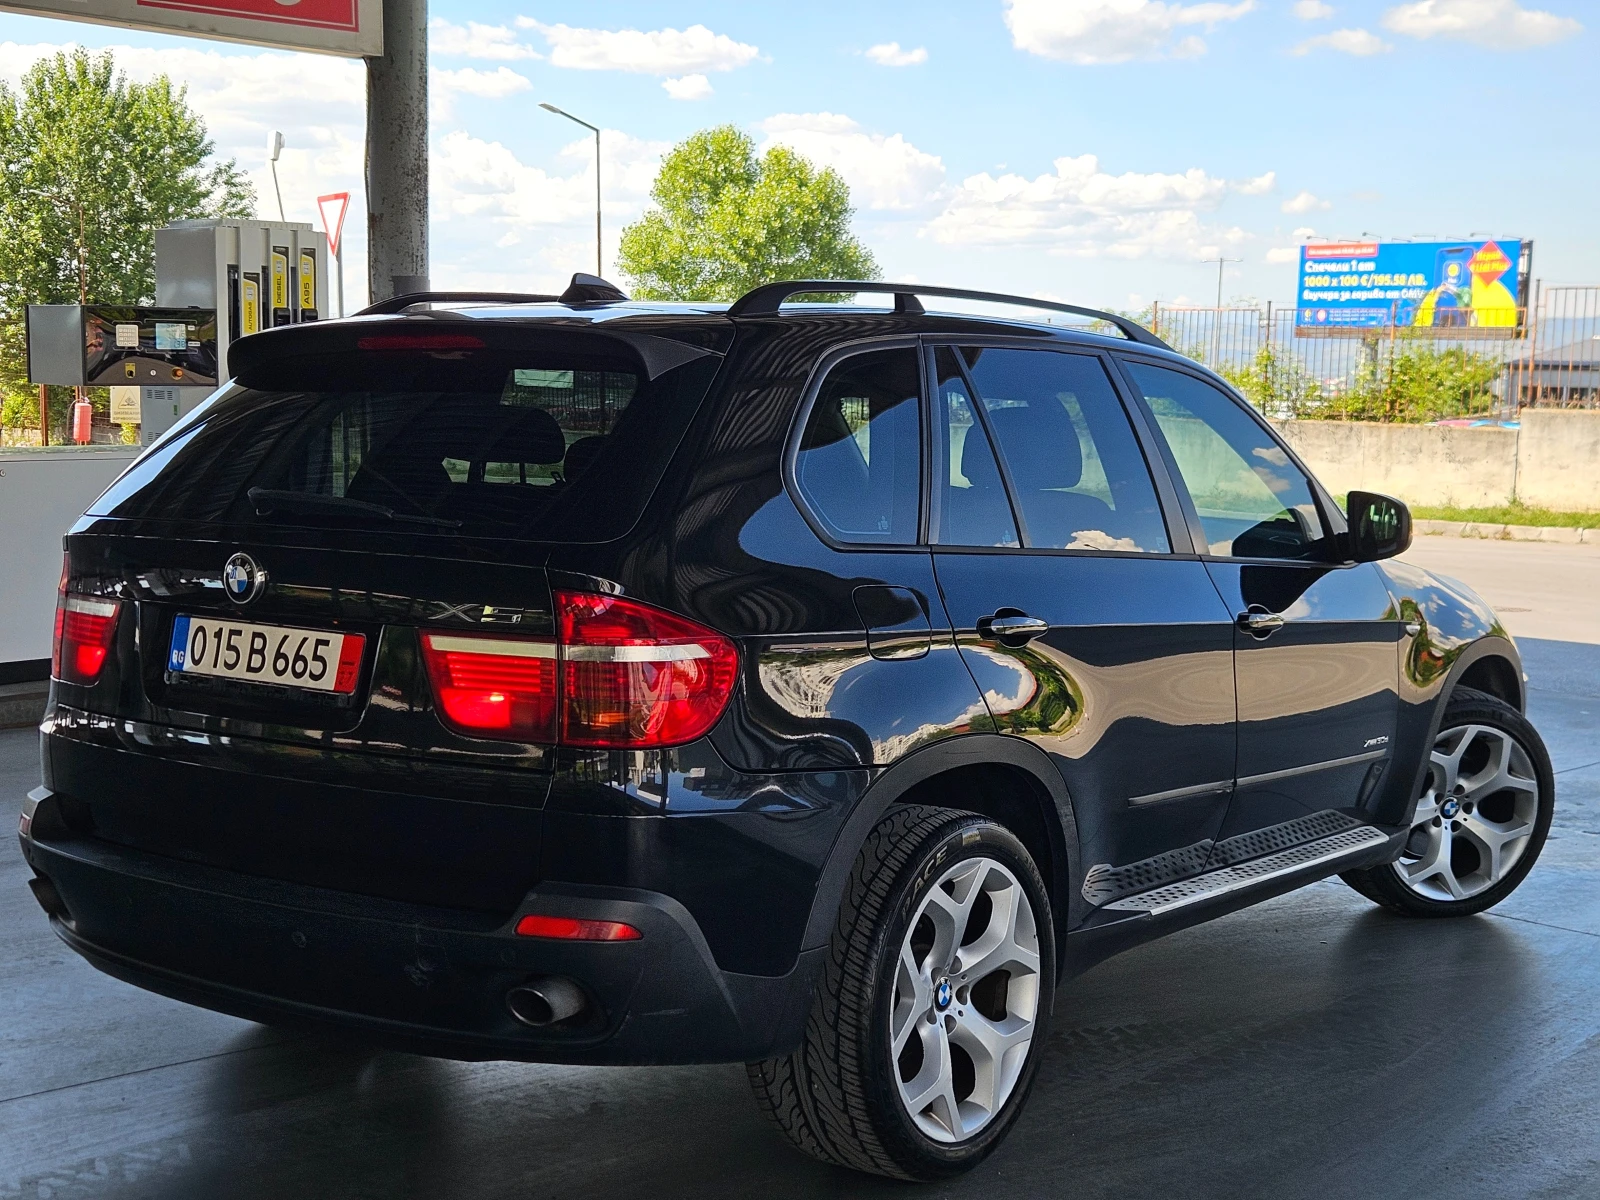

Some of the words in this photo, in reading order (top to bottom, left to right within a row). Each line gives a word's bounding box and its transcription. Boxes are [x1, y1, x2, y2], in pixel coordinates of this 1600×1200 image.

[1305, 261, 1350, 272] Спечели
[1304, 275, 1330, 287] 1000
[1340, 275, 1359, 286] 100
[172, 649, 185, 665] BG
[190, 625, 332, 682] 015B665
